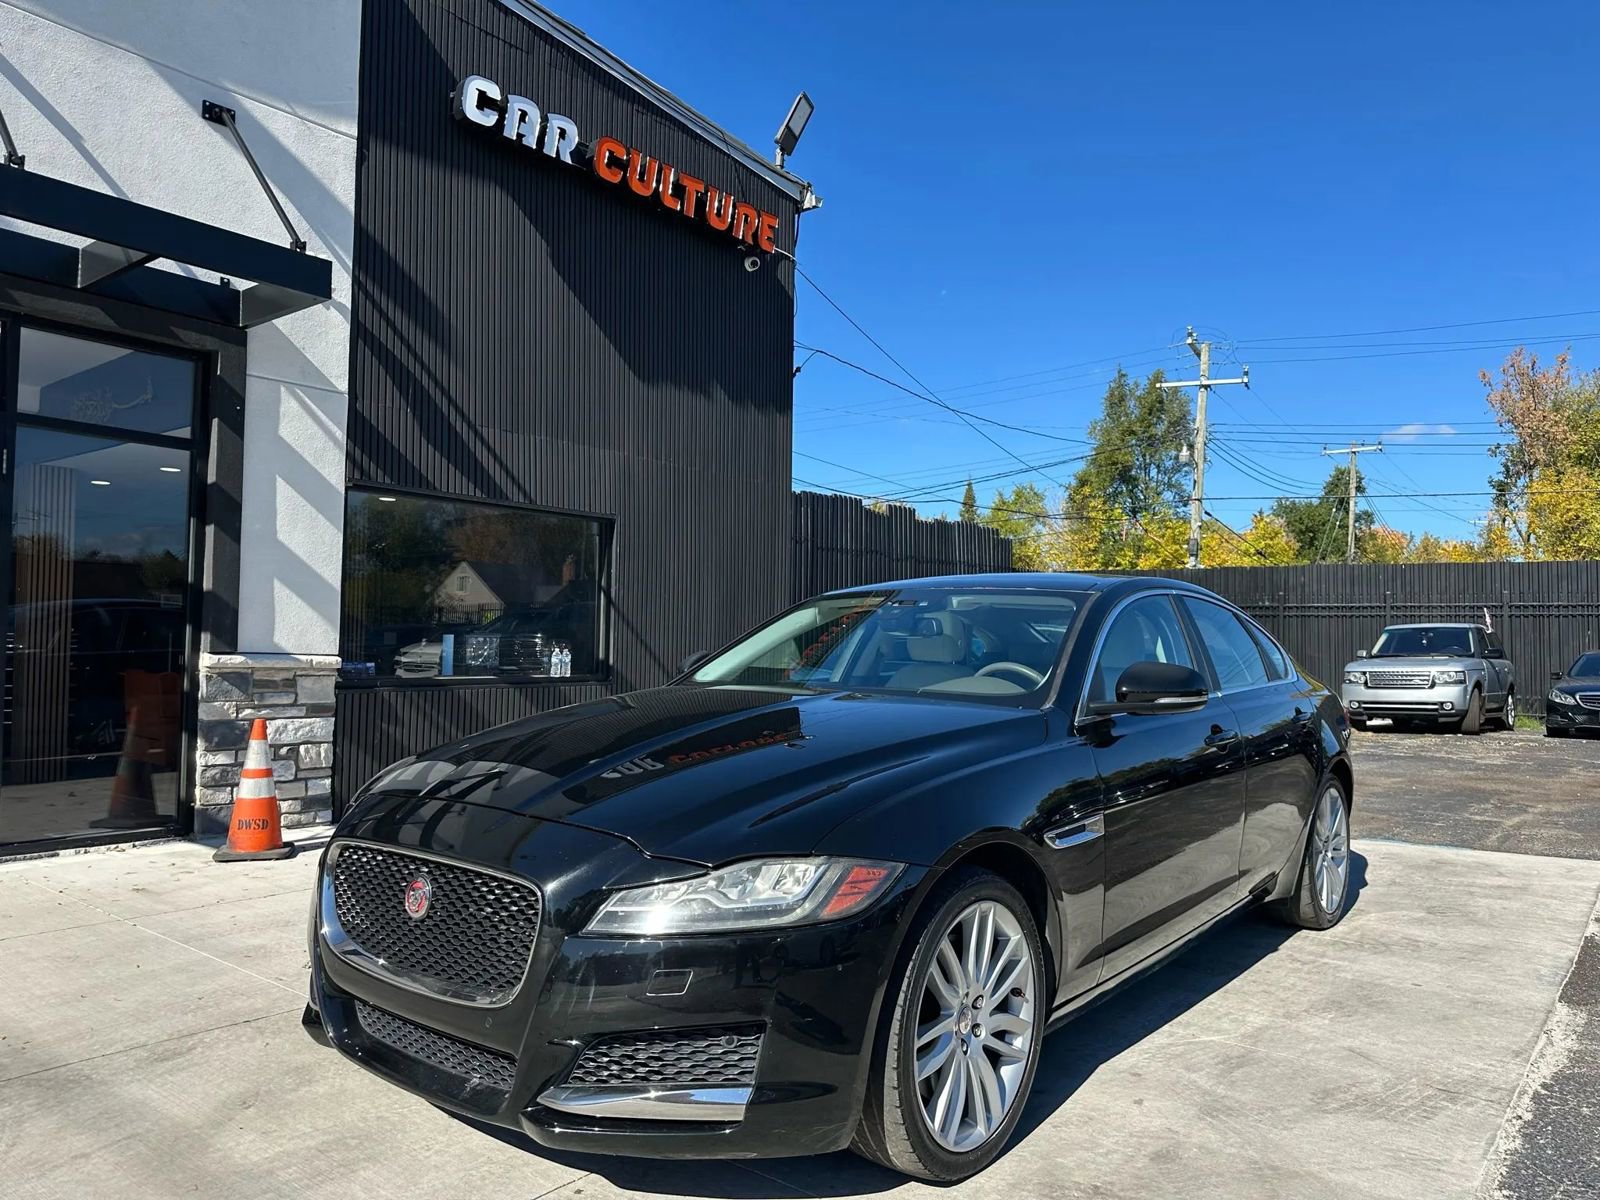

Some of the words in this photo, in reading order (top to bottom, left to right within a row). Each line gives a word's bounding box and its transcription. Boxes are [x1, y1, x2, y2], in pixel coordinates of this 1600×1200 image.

[459, 75, 579, 166] CAR
[592, 136, 778, 253] CULTURE
[237, 818, 269, 831] DWSD
